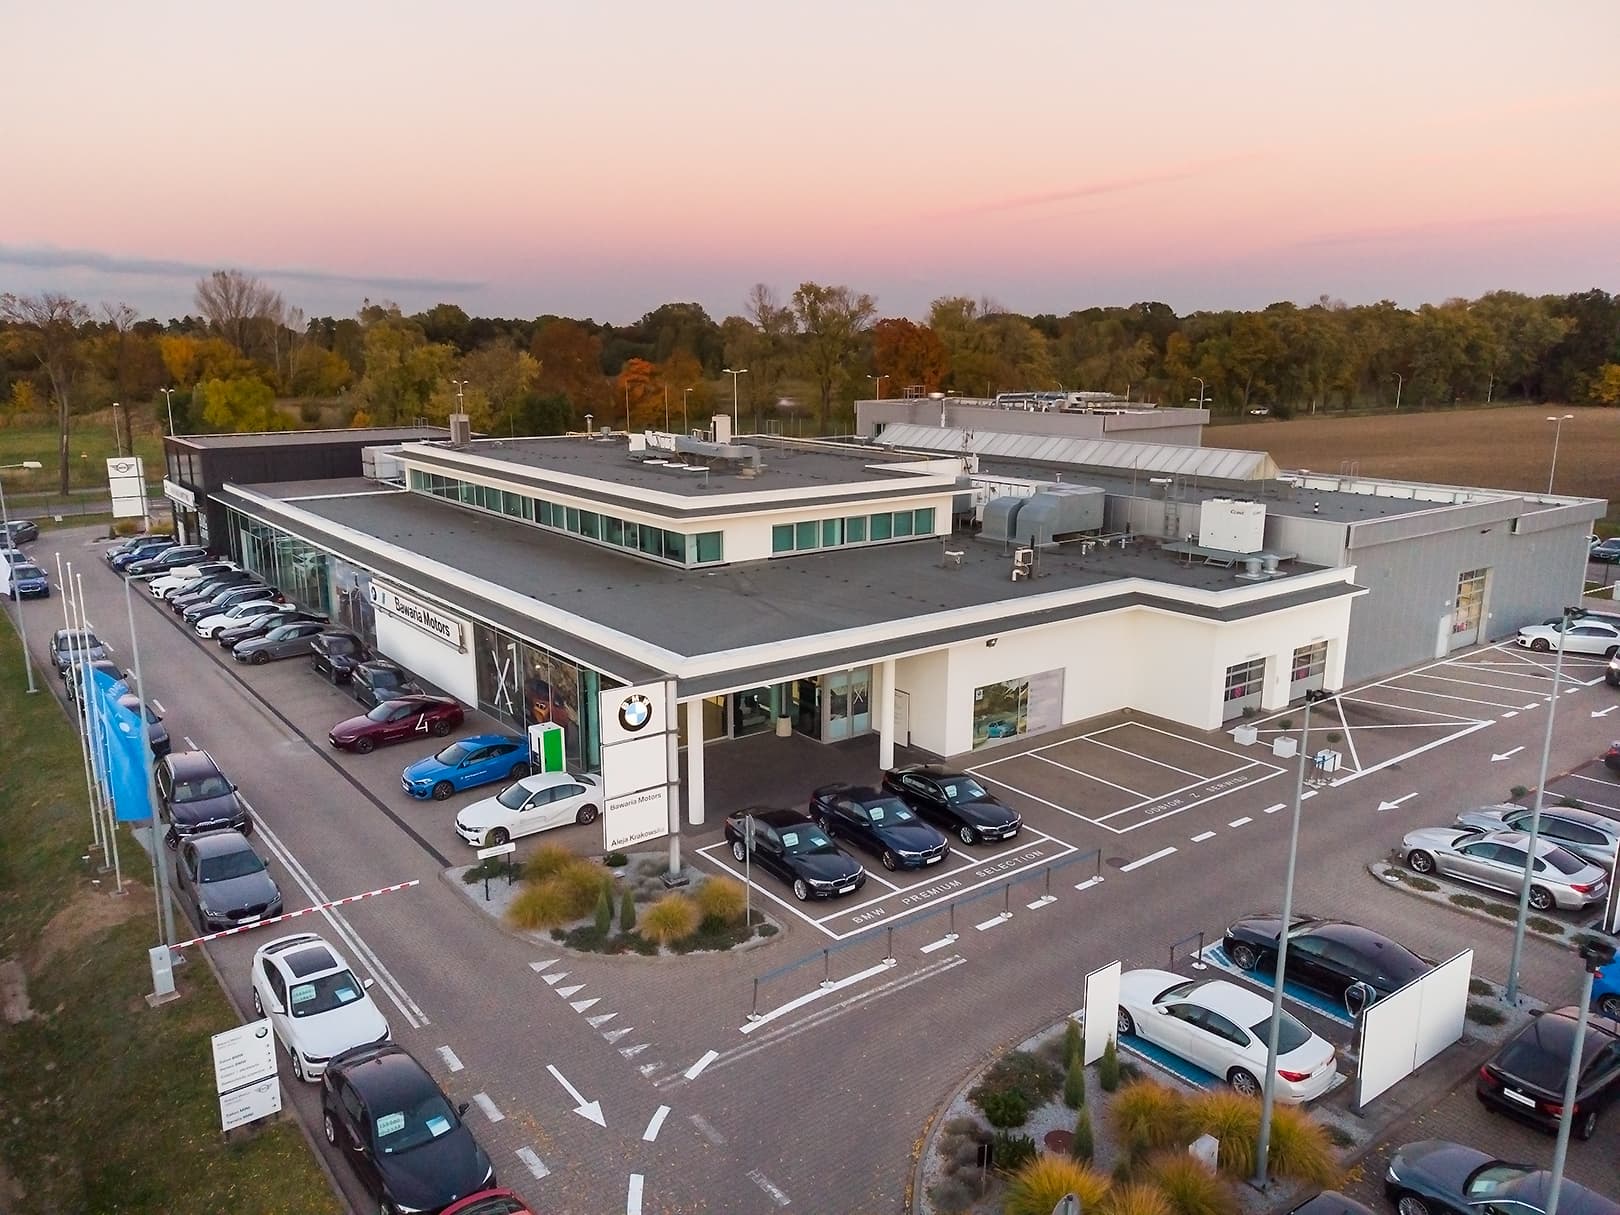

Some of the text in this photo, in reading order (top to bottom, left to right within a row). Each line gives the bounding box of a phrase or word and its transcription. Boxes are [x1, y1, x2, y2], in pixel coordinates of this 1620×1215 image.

[394, 596, 451, 637] Bawaria Motors
[621, 695, 650, 710] BMW
[415, 712, 429, 733] 4
[610, 793, 662, 811] Bawaria Motors
[611, 837, 628, 847] Aleja
[851, 849, 1045, 925] BMW PREMIUM SELECTION
